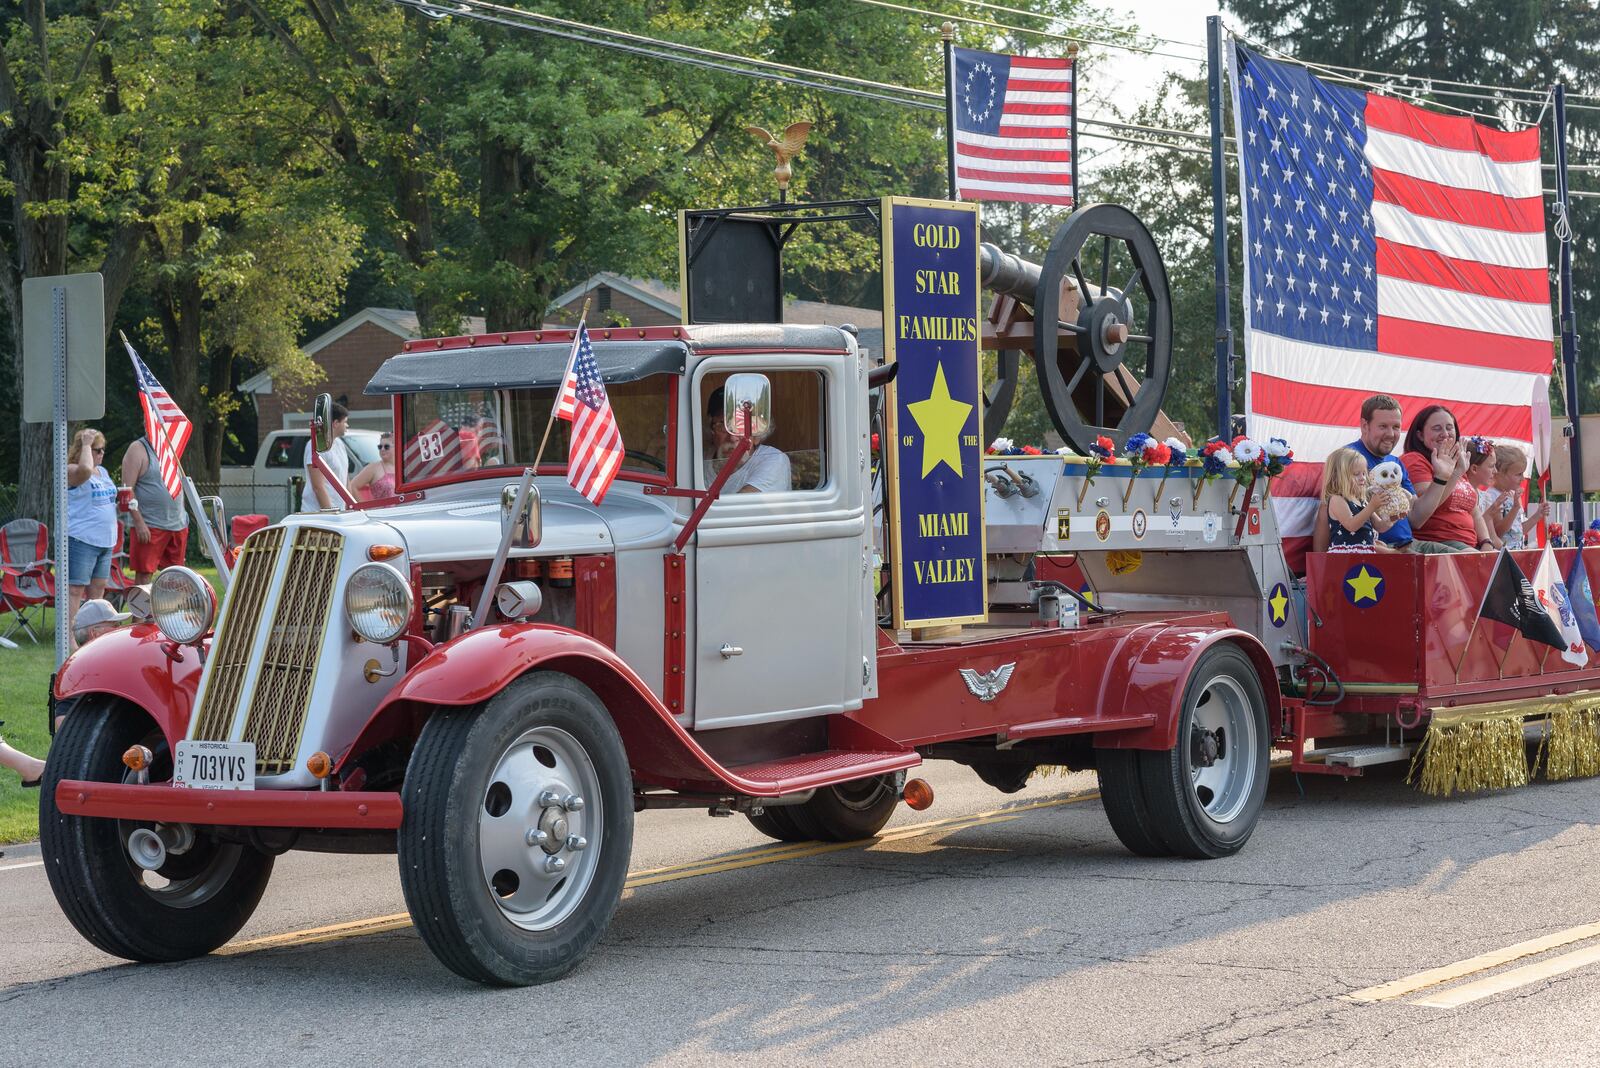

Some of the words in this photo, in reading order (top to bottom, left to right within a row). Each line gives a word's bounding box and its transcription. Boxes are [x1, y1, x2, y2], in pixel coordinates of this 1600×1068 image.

[913, 223, 960, 249] GOLD
[915, 269, 960, 295] STAR
[899, 315, 977, 342] FAMILIES
[421, 433, 442, 460] 33
[903, 435, 914, 447] OF
[963, 435, 978, 446] THE
[918, 512, 969, 538] MIAMI
[913, 558, 976, 585] VALLEY
[176, 751, 184, 782] OHIO
[191, 755, 245, 782] 703YVS
